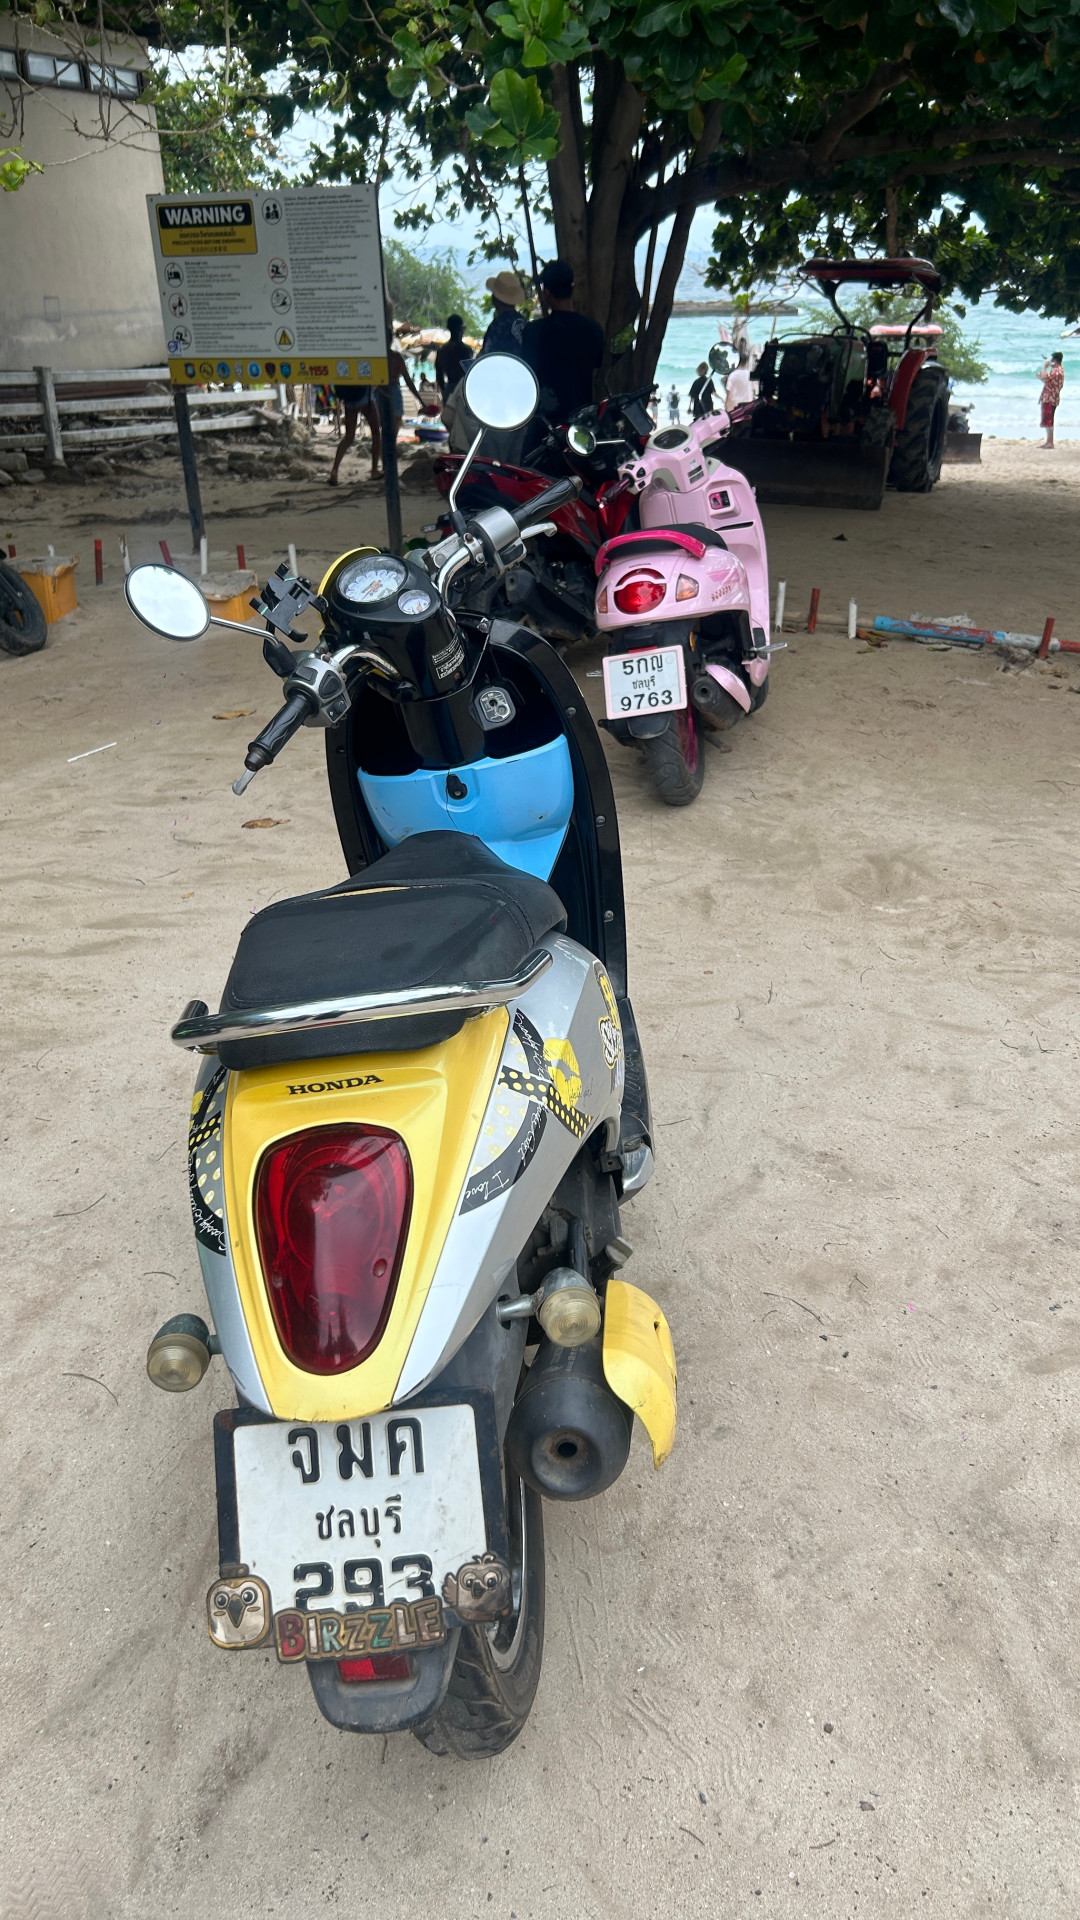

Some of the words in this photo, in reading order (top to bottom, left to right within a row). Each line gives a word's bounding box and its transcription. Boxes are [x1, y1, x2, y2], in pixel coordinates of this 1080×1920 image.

[165, 205, 246, 226] WARNING
[621, 690, 673, 711] 9763
[632, 675, 656, 690] ชลบุรี
[286, 1074, 384, 1096] HONDA
[288, 1417, 425, 1484] จมค
[315, 1494, 402, 1548] ชลบุรี
[293, 1553, 436, 1613] 293
[281, 1601, 444, 1656] BIRZZLE
